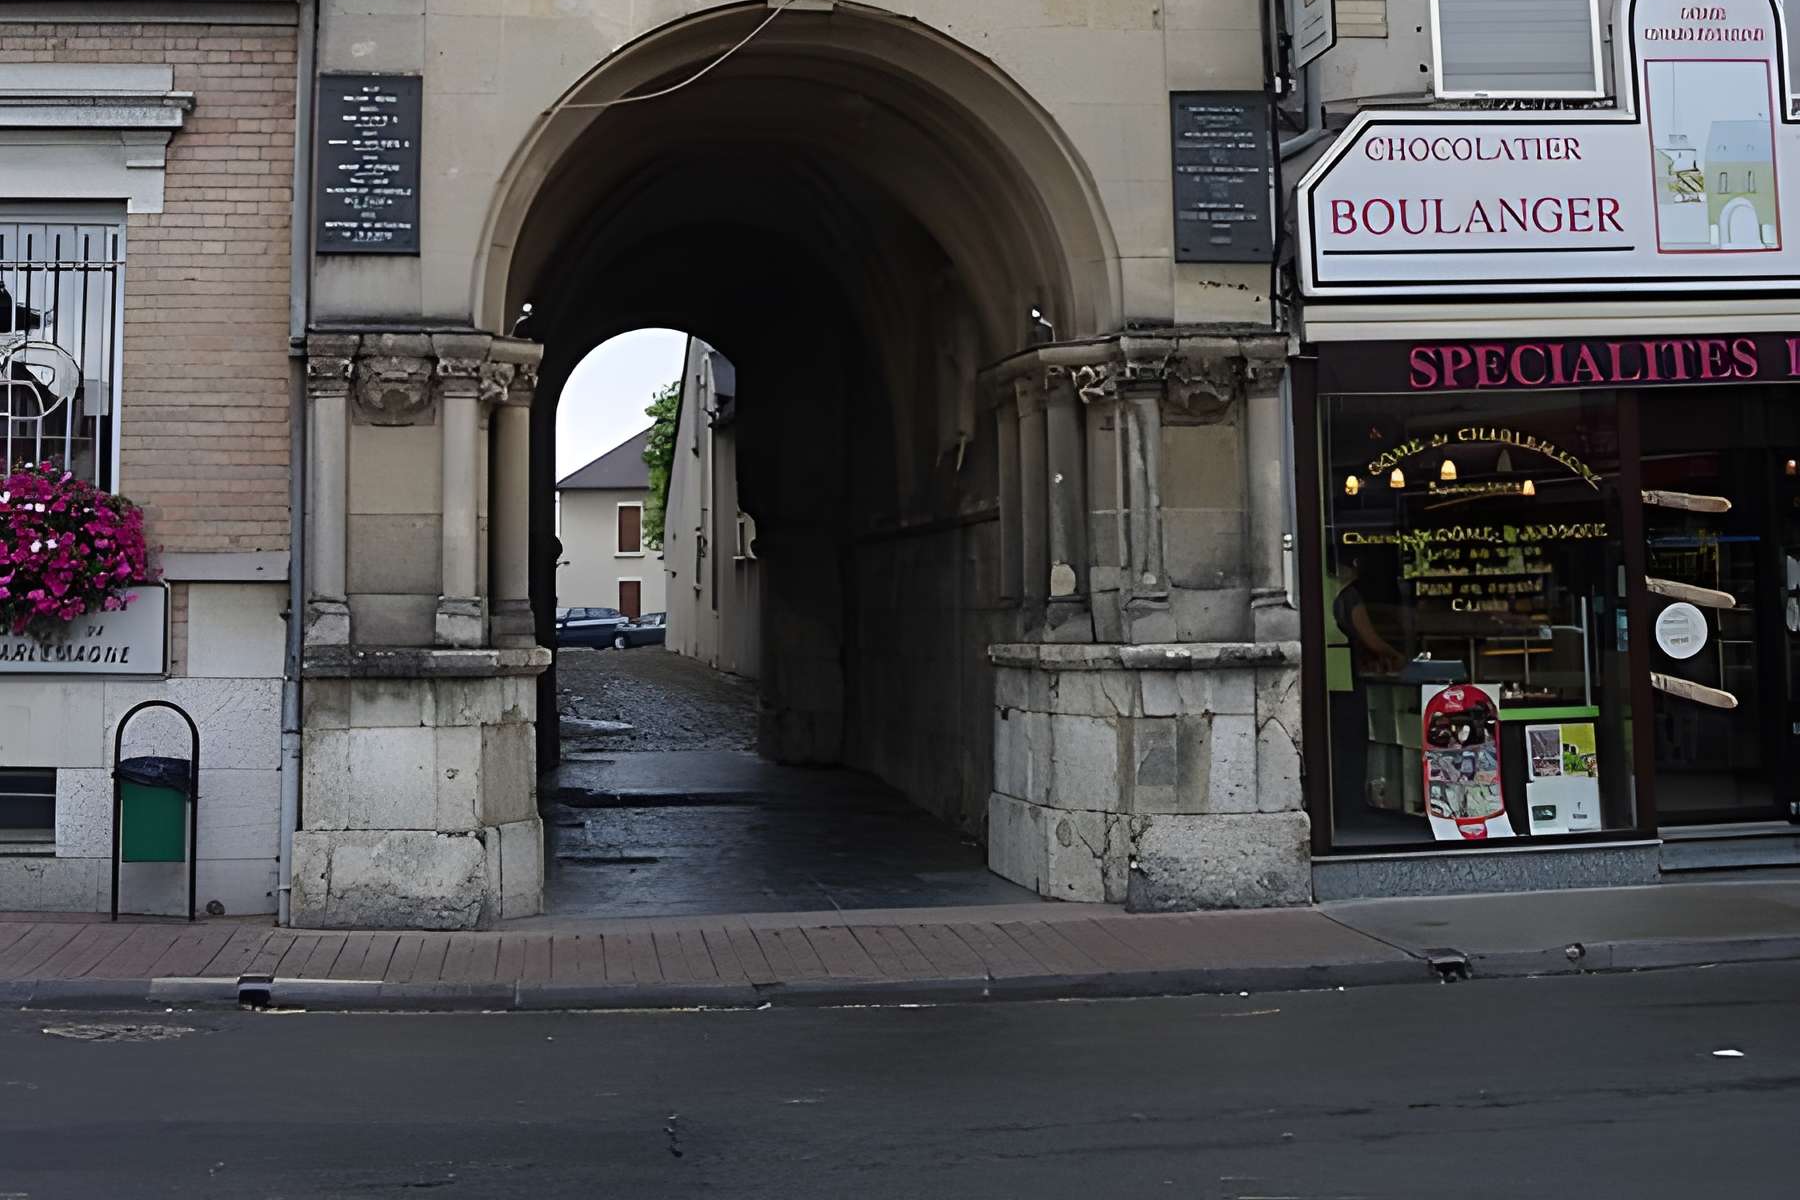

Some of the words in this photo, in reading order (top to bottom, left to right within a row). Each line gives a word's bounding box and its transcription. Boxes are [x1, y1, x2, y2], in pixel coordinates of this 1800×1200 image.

[1364, 136, 1582, 162] CHOCOLATIER
[1331, 197, 1625, 236] BOULANGER
[1410, 338, 1758, 389] SPECIALITES
